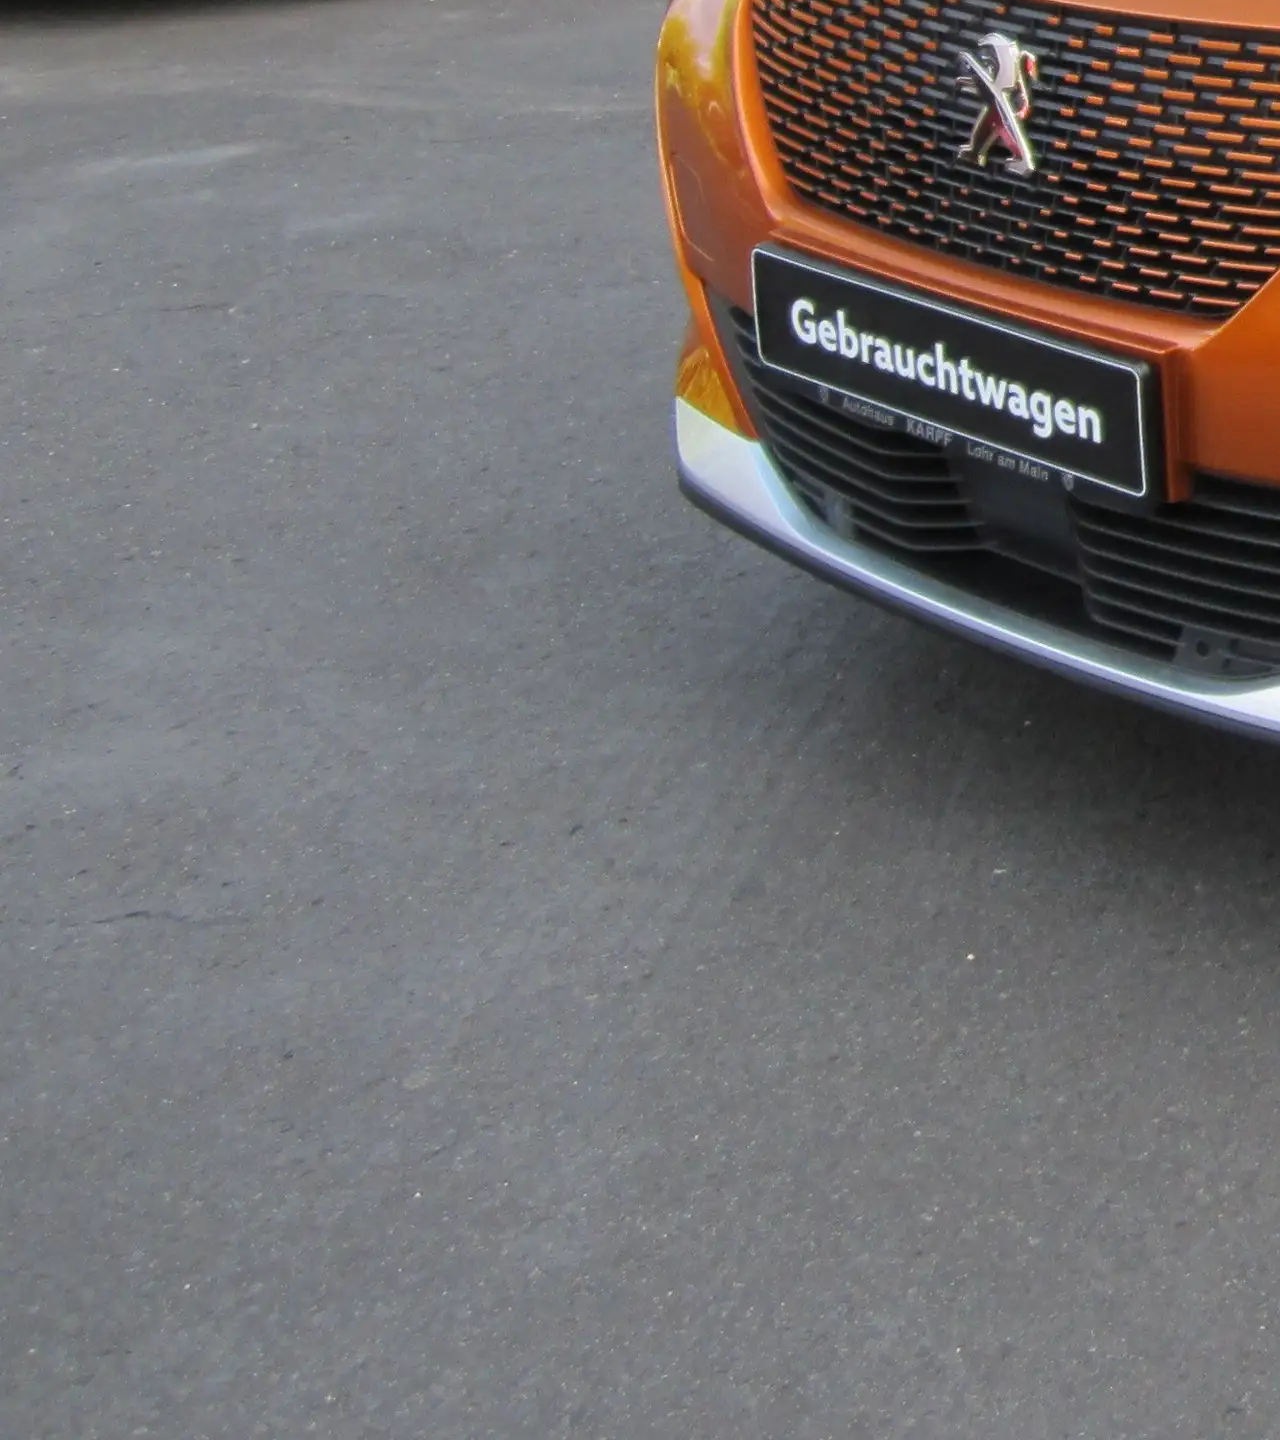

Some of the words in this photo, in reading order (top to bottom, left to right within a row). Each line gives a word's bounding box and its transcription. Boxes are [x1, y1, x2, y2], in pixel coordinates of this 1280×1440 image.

[789, 296, 1104, 444] Gebrauchtwagen
[842, 396, 895, 428] Autohaus
[966, 442, 994, 463] Lohr
[997, 455, 1016, 470] am
[1018, 459, 1049, 481] Main
